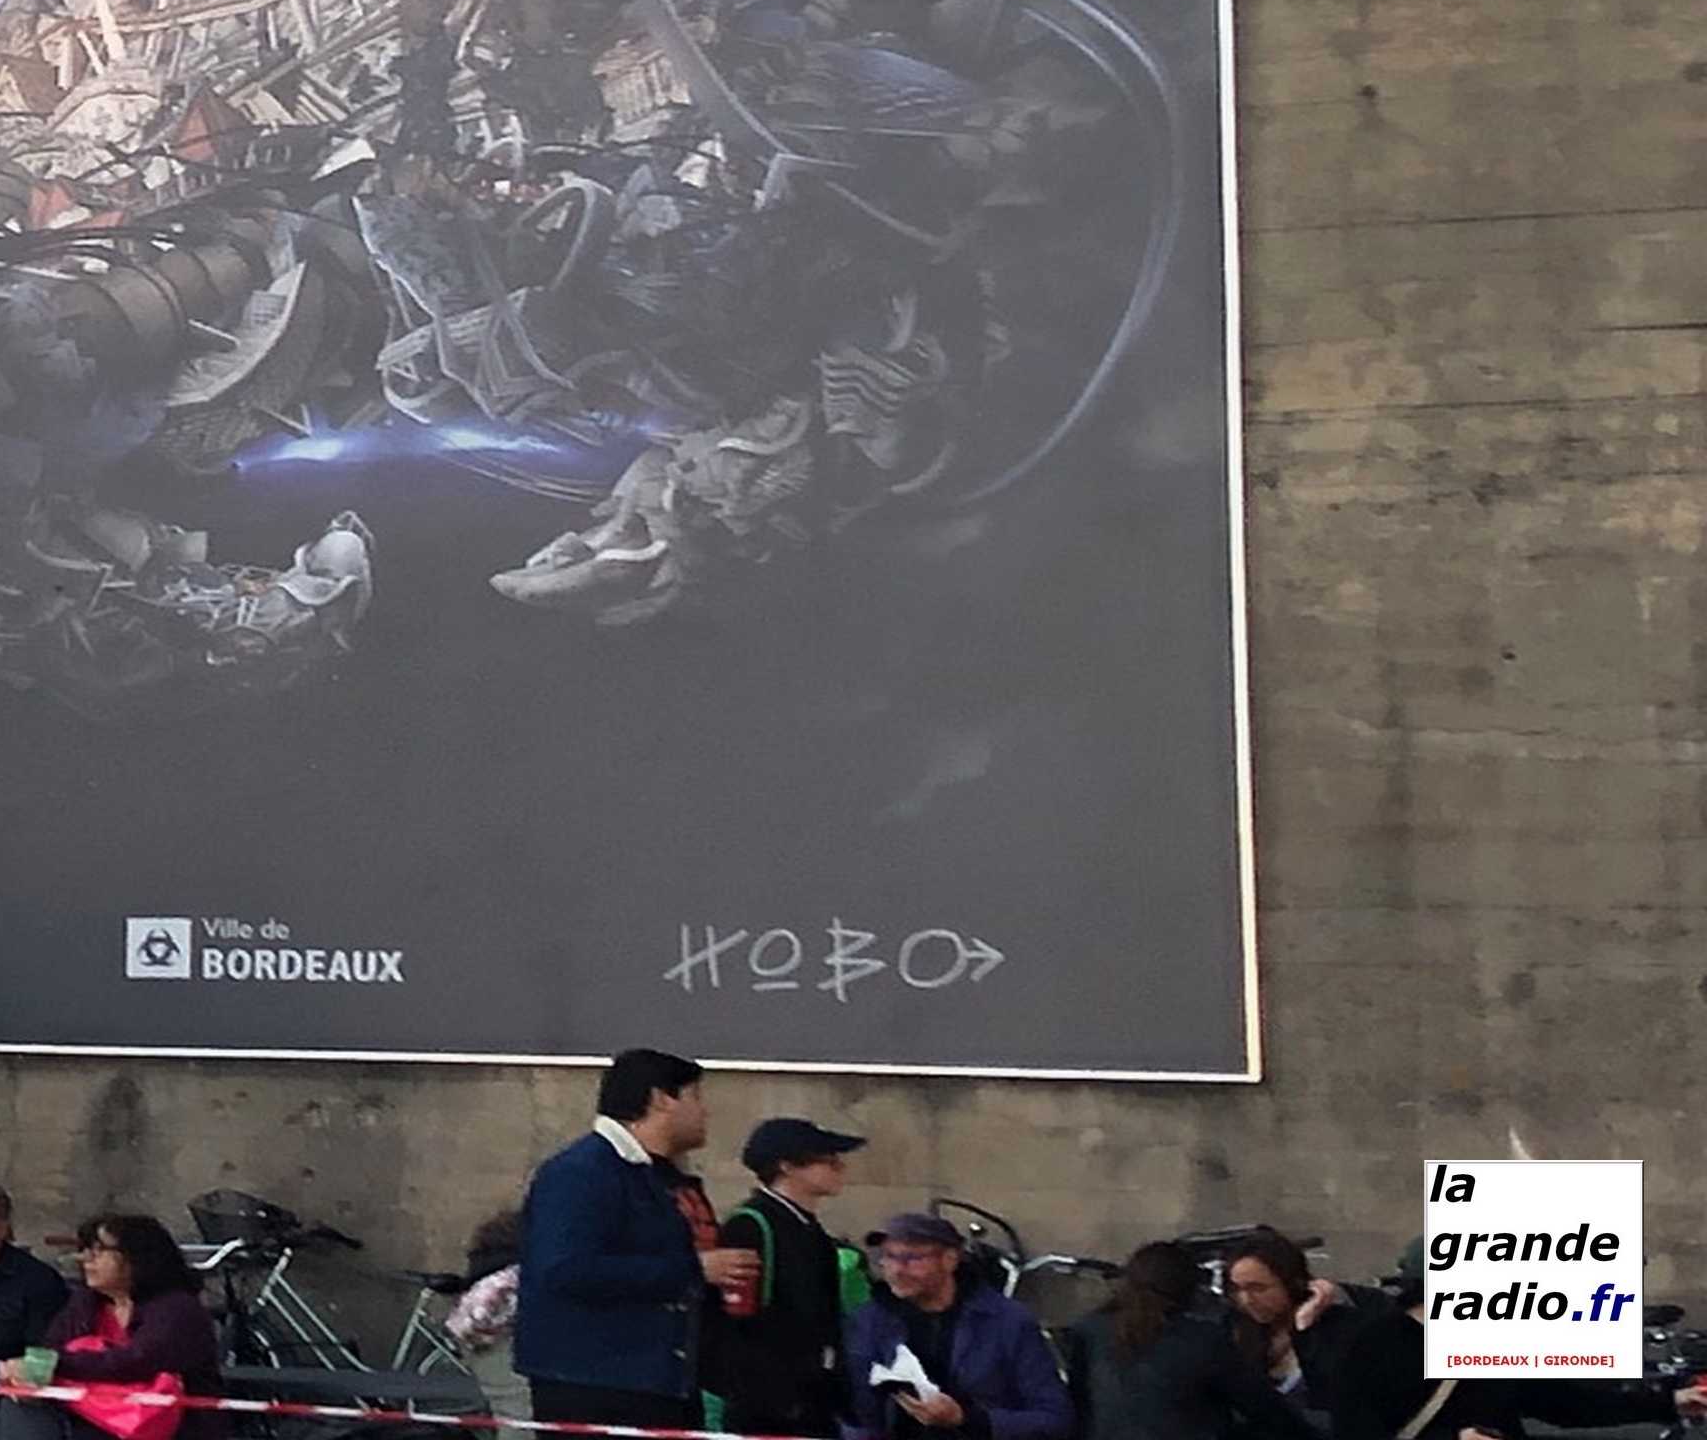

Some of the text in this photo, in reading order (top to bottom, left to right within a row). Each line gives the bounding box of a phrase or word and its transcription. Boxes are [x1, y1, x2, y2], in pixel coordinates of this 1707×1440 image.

[201, 917, 290, 940] Ville de
[201, 947, 404, 982] BORDEAUX
